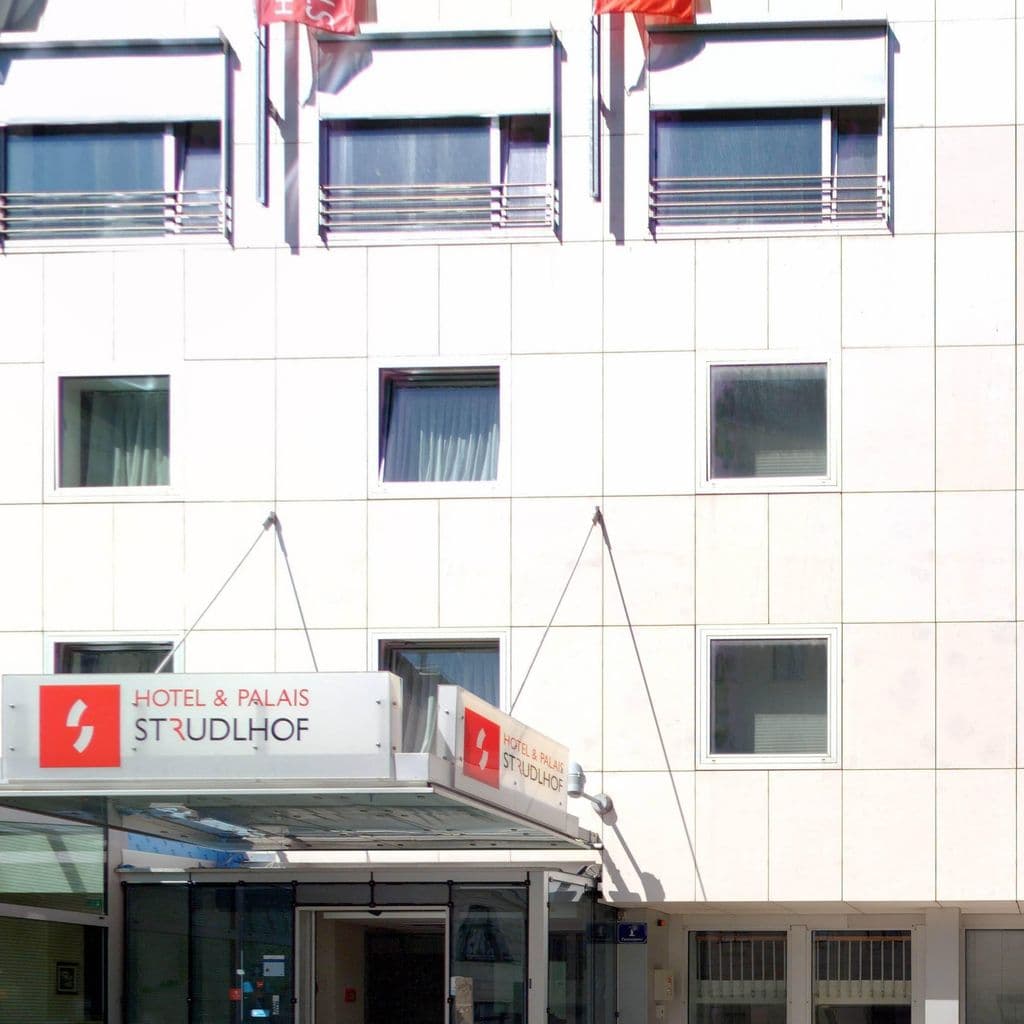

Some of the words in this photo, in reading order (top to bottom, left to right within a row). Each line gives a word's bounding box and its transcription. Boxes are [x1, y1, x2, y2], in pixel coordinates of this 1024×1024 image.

[134, 688, 206, 707] HOTEL
[213, 688, 228, 707] &
[237, 688, 310, 707] PALAIS
[134, 717, 310, 742] STRUDLHOF
[503, 732, 530, 758] HOTEL
[531, 747, 538, 761] &
[540, 751, 564, 774] PALAIS
[503, 751, 564, 793] STRUDLHOF
